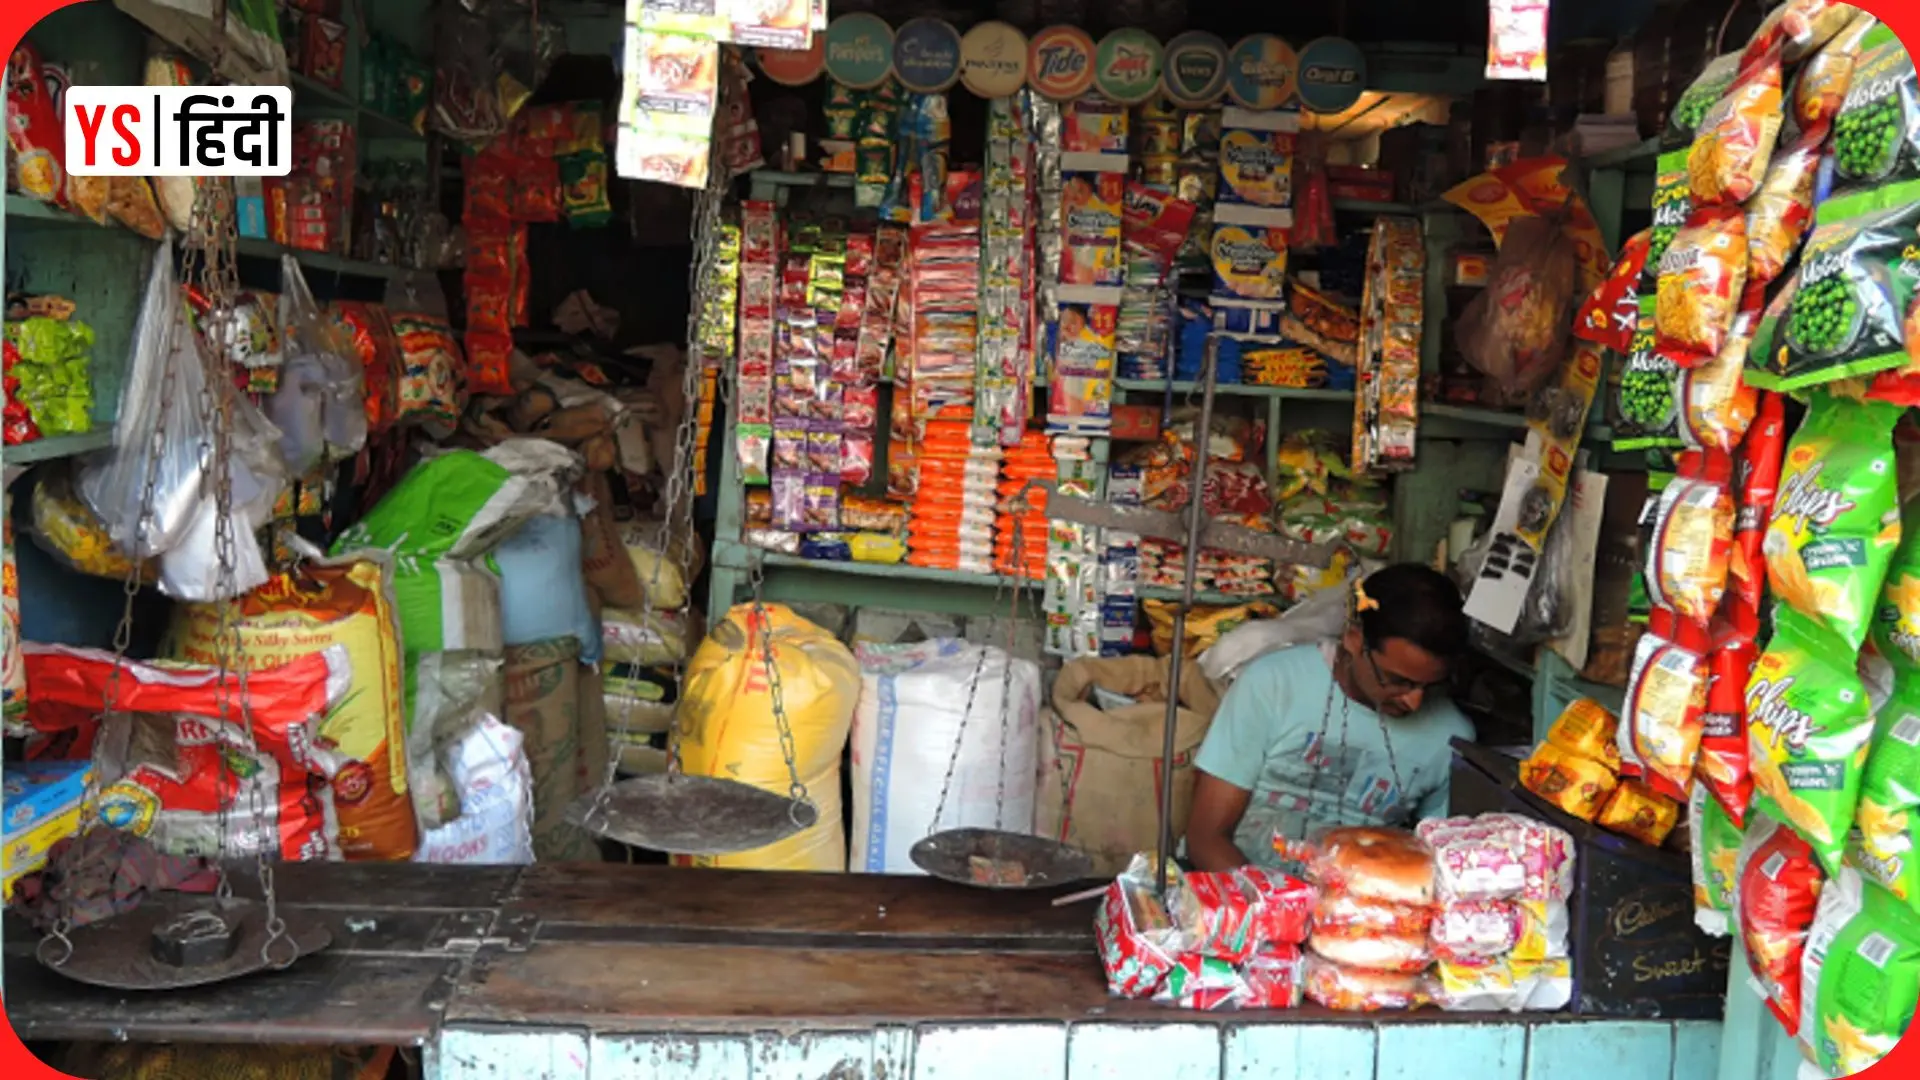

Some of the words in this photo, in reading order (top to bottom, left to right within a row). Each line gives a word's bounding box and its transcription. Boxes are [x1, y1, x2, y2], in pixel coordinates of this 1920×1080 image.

[1038, 46, 1086, 79] Tide
[1094, 312, 1113, 329] 11
[1770, 461, 1857, 536] Chips
[1745, 676, 1828, 750] Chips
[1632, 948, 1706, 982] Sweet
